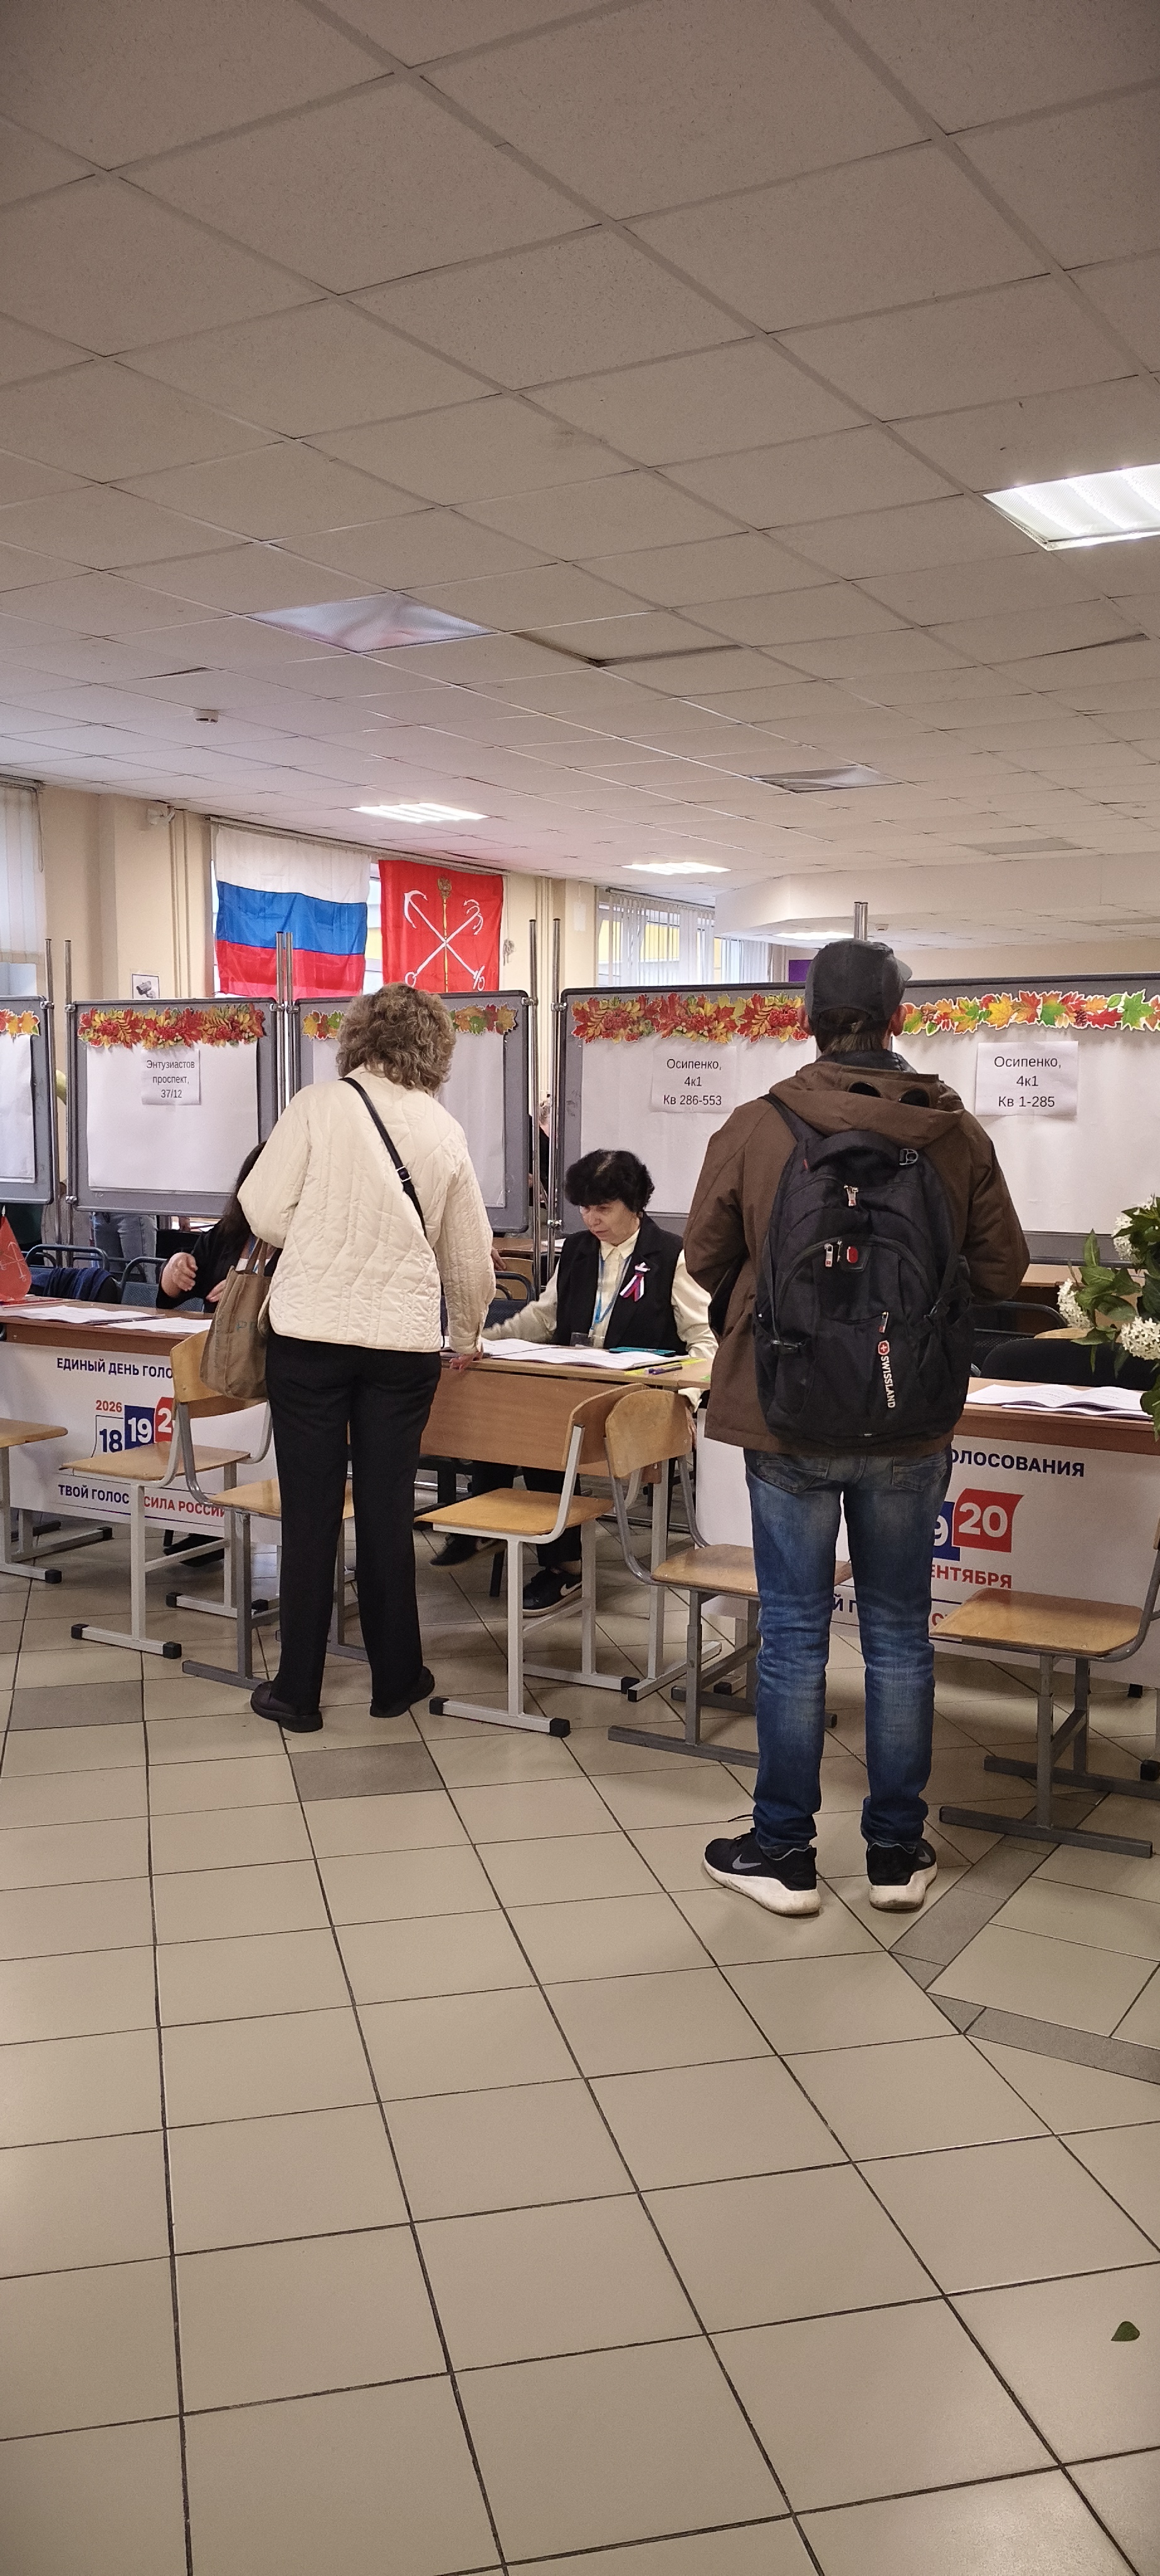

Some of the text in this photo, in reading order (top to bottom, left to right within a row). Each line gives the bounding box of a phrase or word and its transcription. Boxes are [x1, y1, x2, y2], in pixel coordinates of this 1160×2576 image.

[146, 1060, 195, 1070] Энтузиастов
[666, 1058, 722, 1070] Осипенко,
[994, 1056, 1061, 1069] Осипенко,
[152, 1076, 189, 1085] проспект,
[684, 1076, 702, 1087] 4к1
[1016, 1075, 1039, 1087] 4к1
[160, 1089, 182, 1098] 37/12
[663, 1094, 722, 1106] Кв 286-553
[998, 1096, 1055, 1108] Кв 1-285
[57, 1357, 174, 1379] ЕДИНЫЙ ДЕНЬ ГОЛО
[880, 1355, 896, 1408] SWISSLAND
[96, 1399, 123, 1413] 2026
[99, 1407, 176, 1453] 18 19 2
[951, 1448, 1085, 1477] ОЛОСОВАНИЯ
[58, 1484, 89, 1499] ТВОЙ
[91, 1488, 130, 1504] ГОЛОС
[143, 1496, 176, 1511] СИЛА
[934, 1502, 1008, 1546] 9 20
